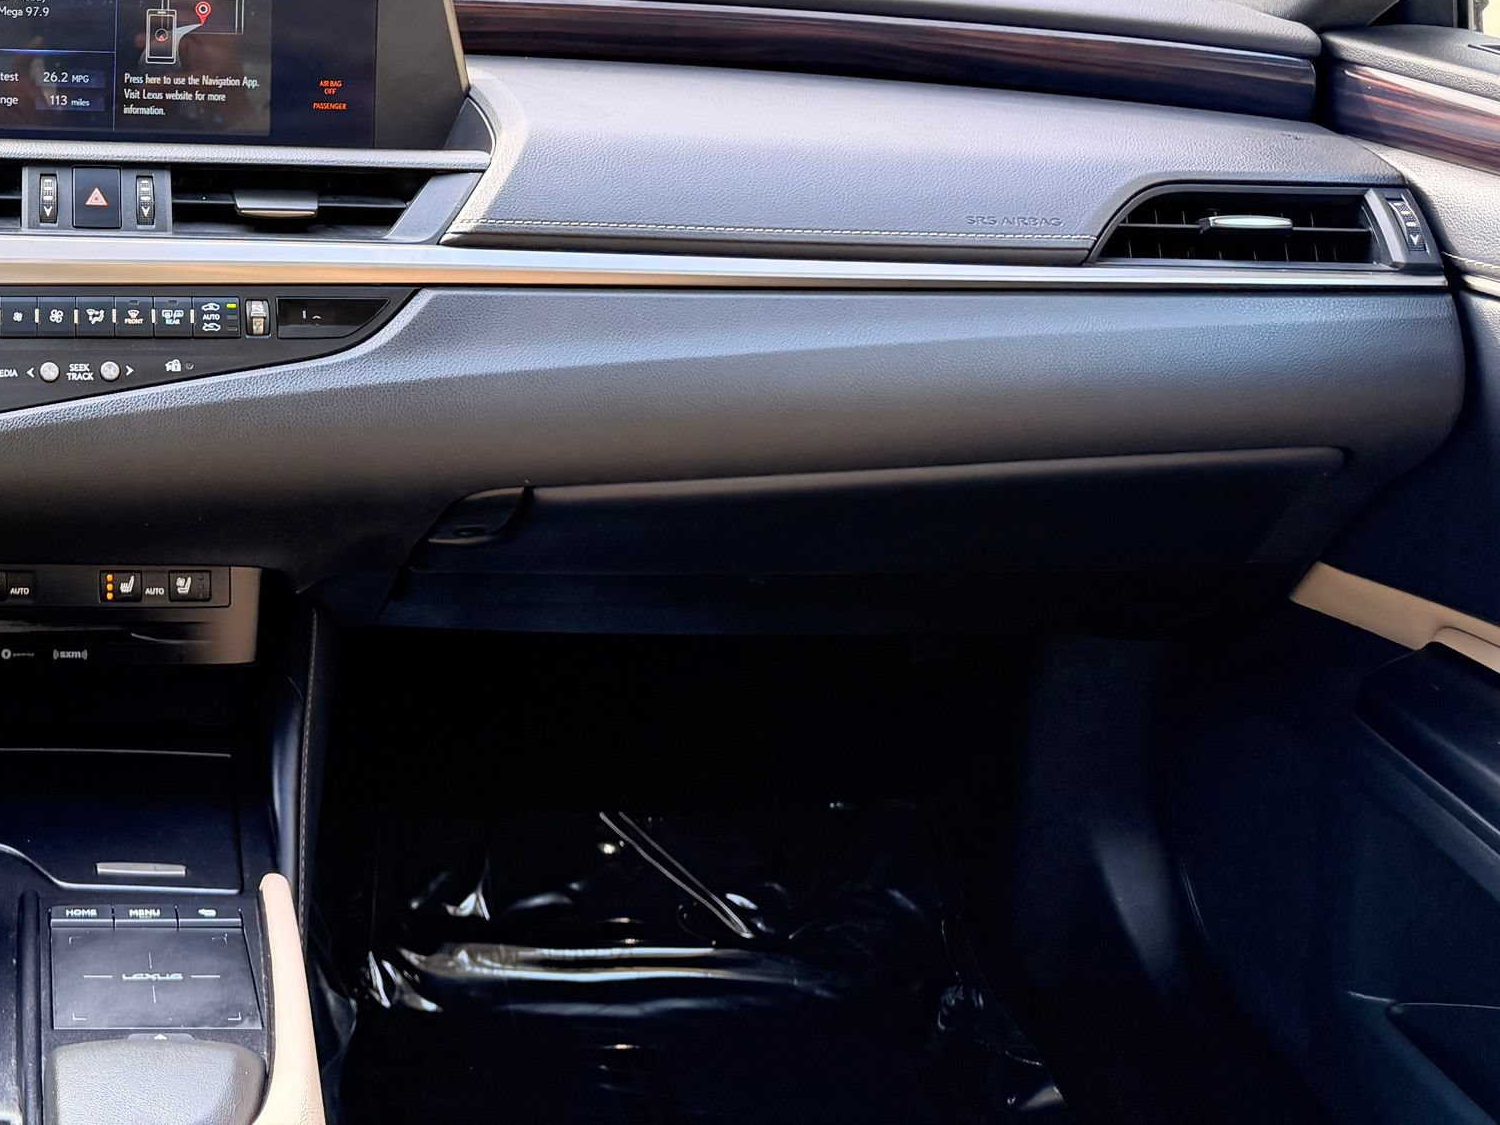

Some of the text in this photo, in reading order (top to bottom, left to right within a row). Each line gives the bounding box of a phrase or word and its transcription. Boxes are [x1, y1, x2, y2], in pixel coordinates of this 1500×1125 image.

[25, 6, 50, 17] 97.9
[42, 71, 68, 83] 26.2
[71, 75, 90, 84] MPG
[124, 72, 260, 89] Press here to use the Navigation App.
[330, 80, 343, 88] BAG
[123, 88, 227, 102] Visit Lexus website for more
[50, 94, 68, 106] 113
[71, 98, 91, 106] miles
[123, 104, 166, 115] information.
[312, 102, 347, 111] PASSENGER
[966, 215, 1063, 227] SRS AIRBAG
[202, 313, 220, 321] AUTO
[69, 363, 90, 372] SEEK
[66, 372, 94, 381] TRACK
[10, 586, 30, 595] AUTO
[145, 586, 165, 595] AUTO
[65, 908, 98, 917] HOME
[129, 908, 161, 917] MENU
[122, 972, 184, 981] LEXUS
